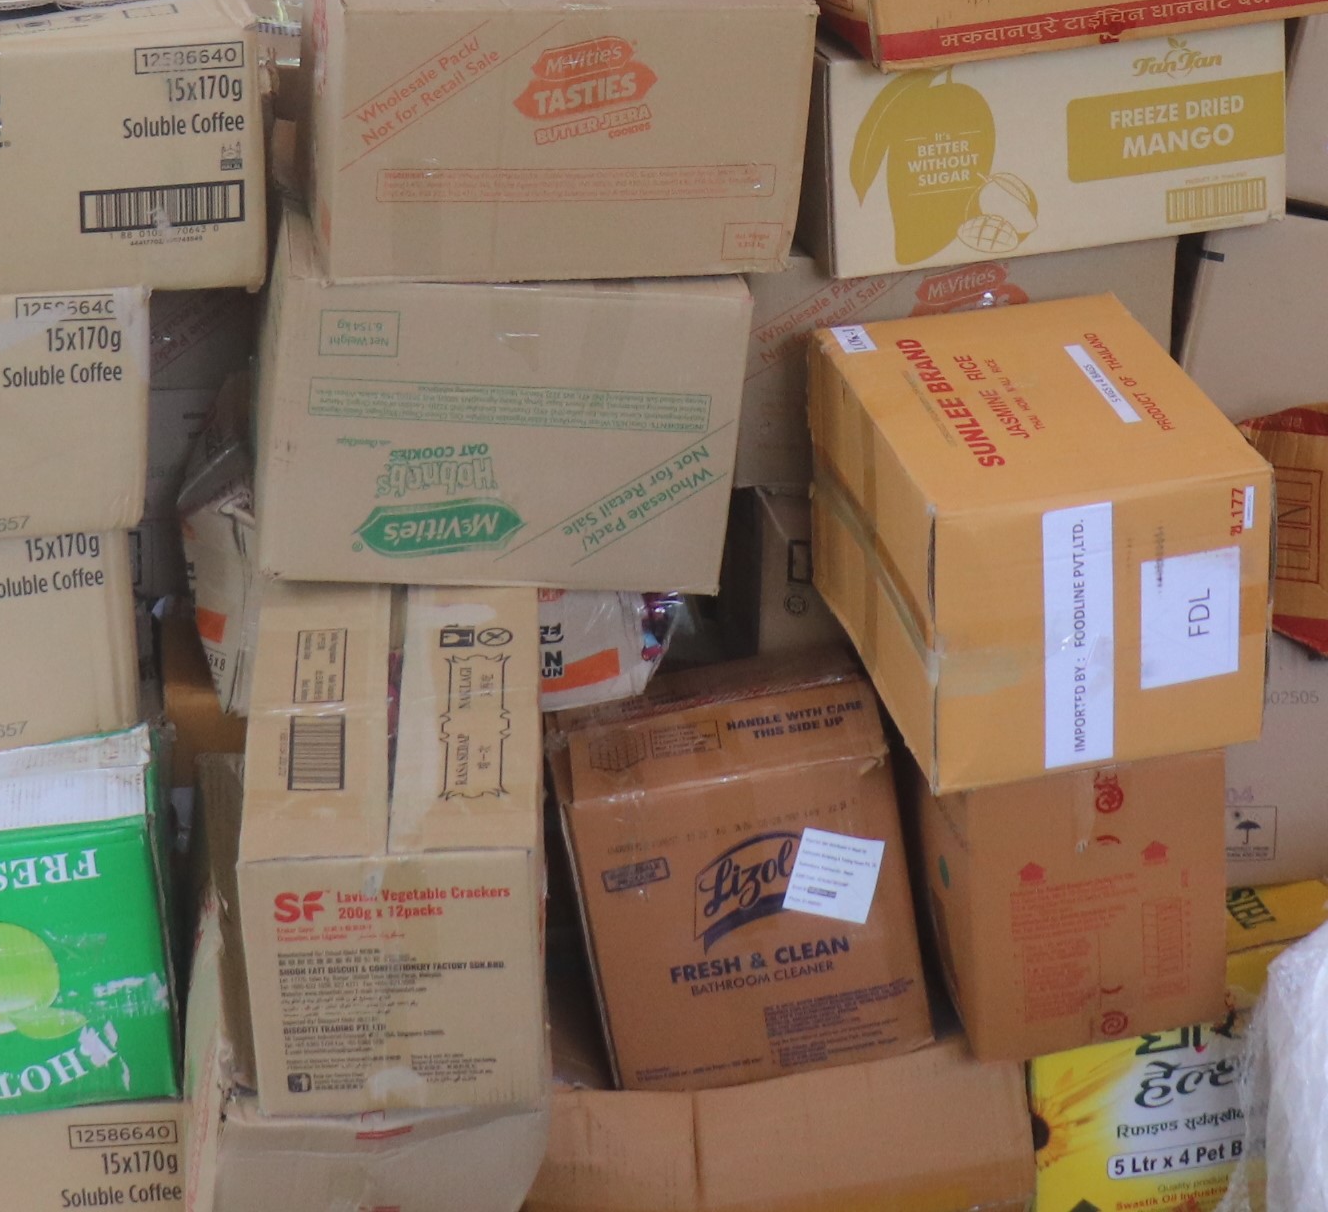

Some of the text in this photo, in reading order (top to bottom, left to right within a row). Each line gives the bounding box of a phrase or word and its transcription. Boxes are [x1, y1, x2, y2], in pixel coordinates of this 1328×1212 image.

[941, 17, 1056, 49] मकवानपुरे
[544, 44, 623, 76] McVitie's
[167, 75, 243, 102] 15x170g
[361, 49, 500, 146] Not for Retail Sale
[533, 72, 636, 116] TASTIES
[123, 112, 245, 139] Soluble Coffee
[535, 105, 652, 145] BUTTER JEERA
[1110, 95, 1245, 130] FREEZE DRIED
[918, 142, 969, 157] BETTER
[1122, 123, 1234, 160] MANGO
[908, 154, 978, 172] WITHOUT
[918, 170, 969, 186] SUGAR
[45, 327, 121, 353] 15x170g
[330, 336, 389, 347] Net Weight
[2, 363, 123, 388] Soluble Coffee
[1084, 332, 1174, 432] PRODUCT OF THAILAND
[896, 339, 1006, 467] SUNLEE BRAND
[953, 354, 1029, 439] JASMINE RICE
[390, 443, 488, 461] OAT COOKIES
[563, 445, 710, 536] Not for Retail Sale
[384, 512, 500, 540] McVitie's
[1074, 580, 1085, 648] FOODLINE
[1189, 588, 1210, 637] FDL
[1075, 666, 1085, 682] BY
[727, 701, 863, 731] HANDLE WITH CARE
[753, 717, 843, 739] THIS SIDE UP
[699, 840, 800, 916] Lizol
[274, 891, 324, 923] SF
[382, 888, 446, 903] Vegetable
[451, 887, 510, 899] Crackers
[338, 907, 371, 921] 200g
[389, 905, 443, 918] 12packs
[670, 936, 850, 983] FRESH & CLEAN
[691, 961, 834, 997] BATHROOM CLEANER
[76, 1125, 170, 1142] 12586640
[101, 1152, 178, 1175] 15x170g
[1114, 1145, 1225, 1175] 5 Ltr x 4 Pet
[61, 1185, 182, 1208] Soluble Coffee
